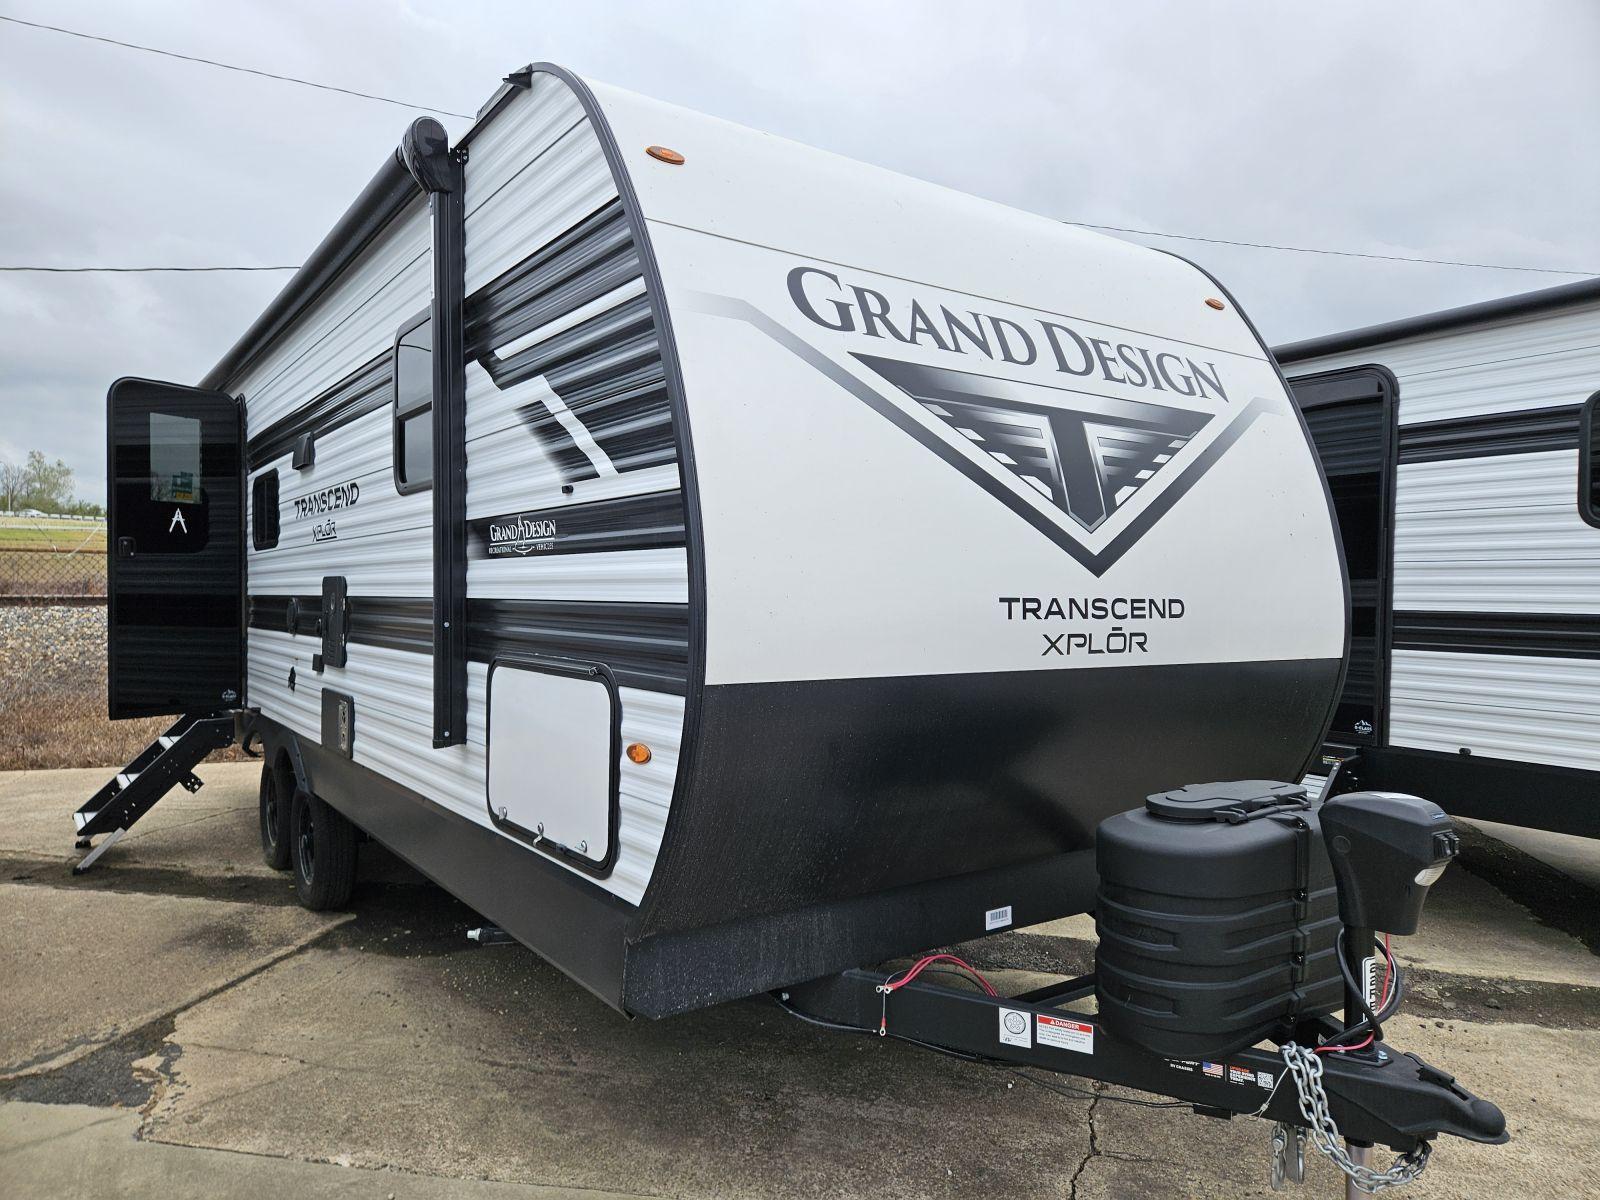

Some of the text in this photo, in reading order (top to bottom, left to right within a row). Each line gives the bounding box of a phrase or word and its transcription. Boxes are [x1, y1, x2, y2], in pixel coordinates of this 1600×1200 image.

[787, 266, 1229, 403] GRAND DESIGN
[294, 482, 360, 519] TRANSCEND
[490, 519, 556, 541] GRAND DESIGN
[999, 597, 1185, 620] TRANSCEND
[1055, 1020, 1080, 1031] DANGER
